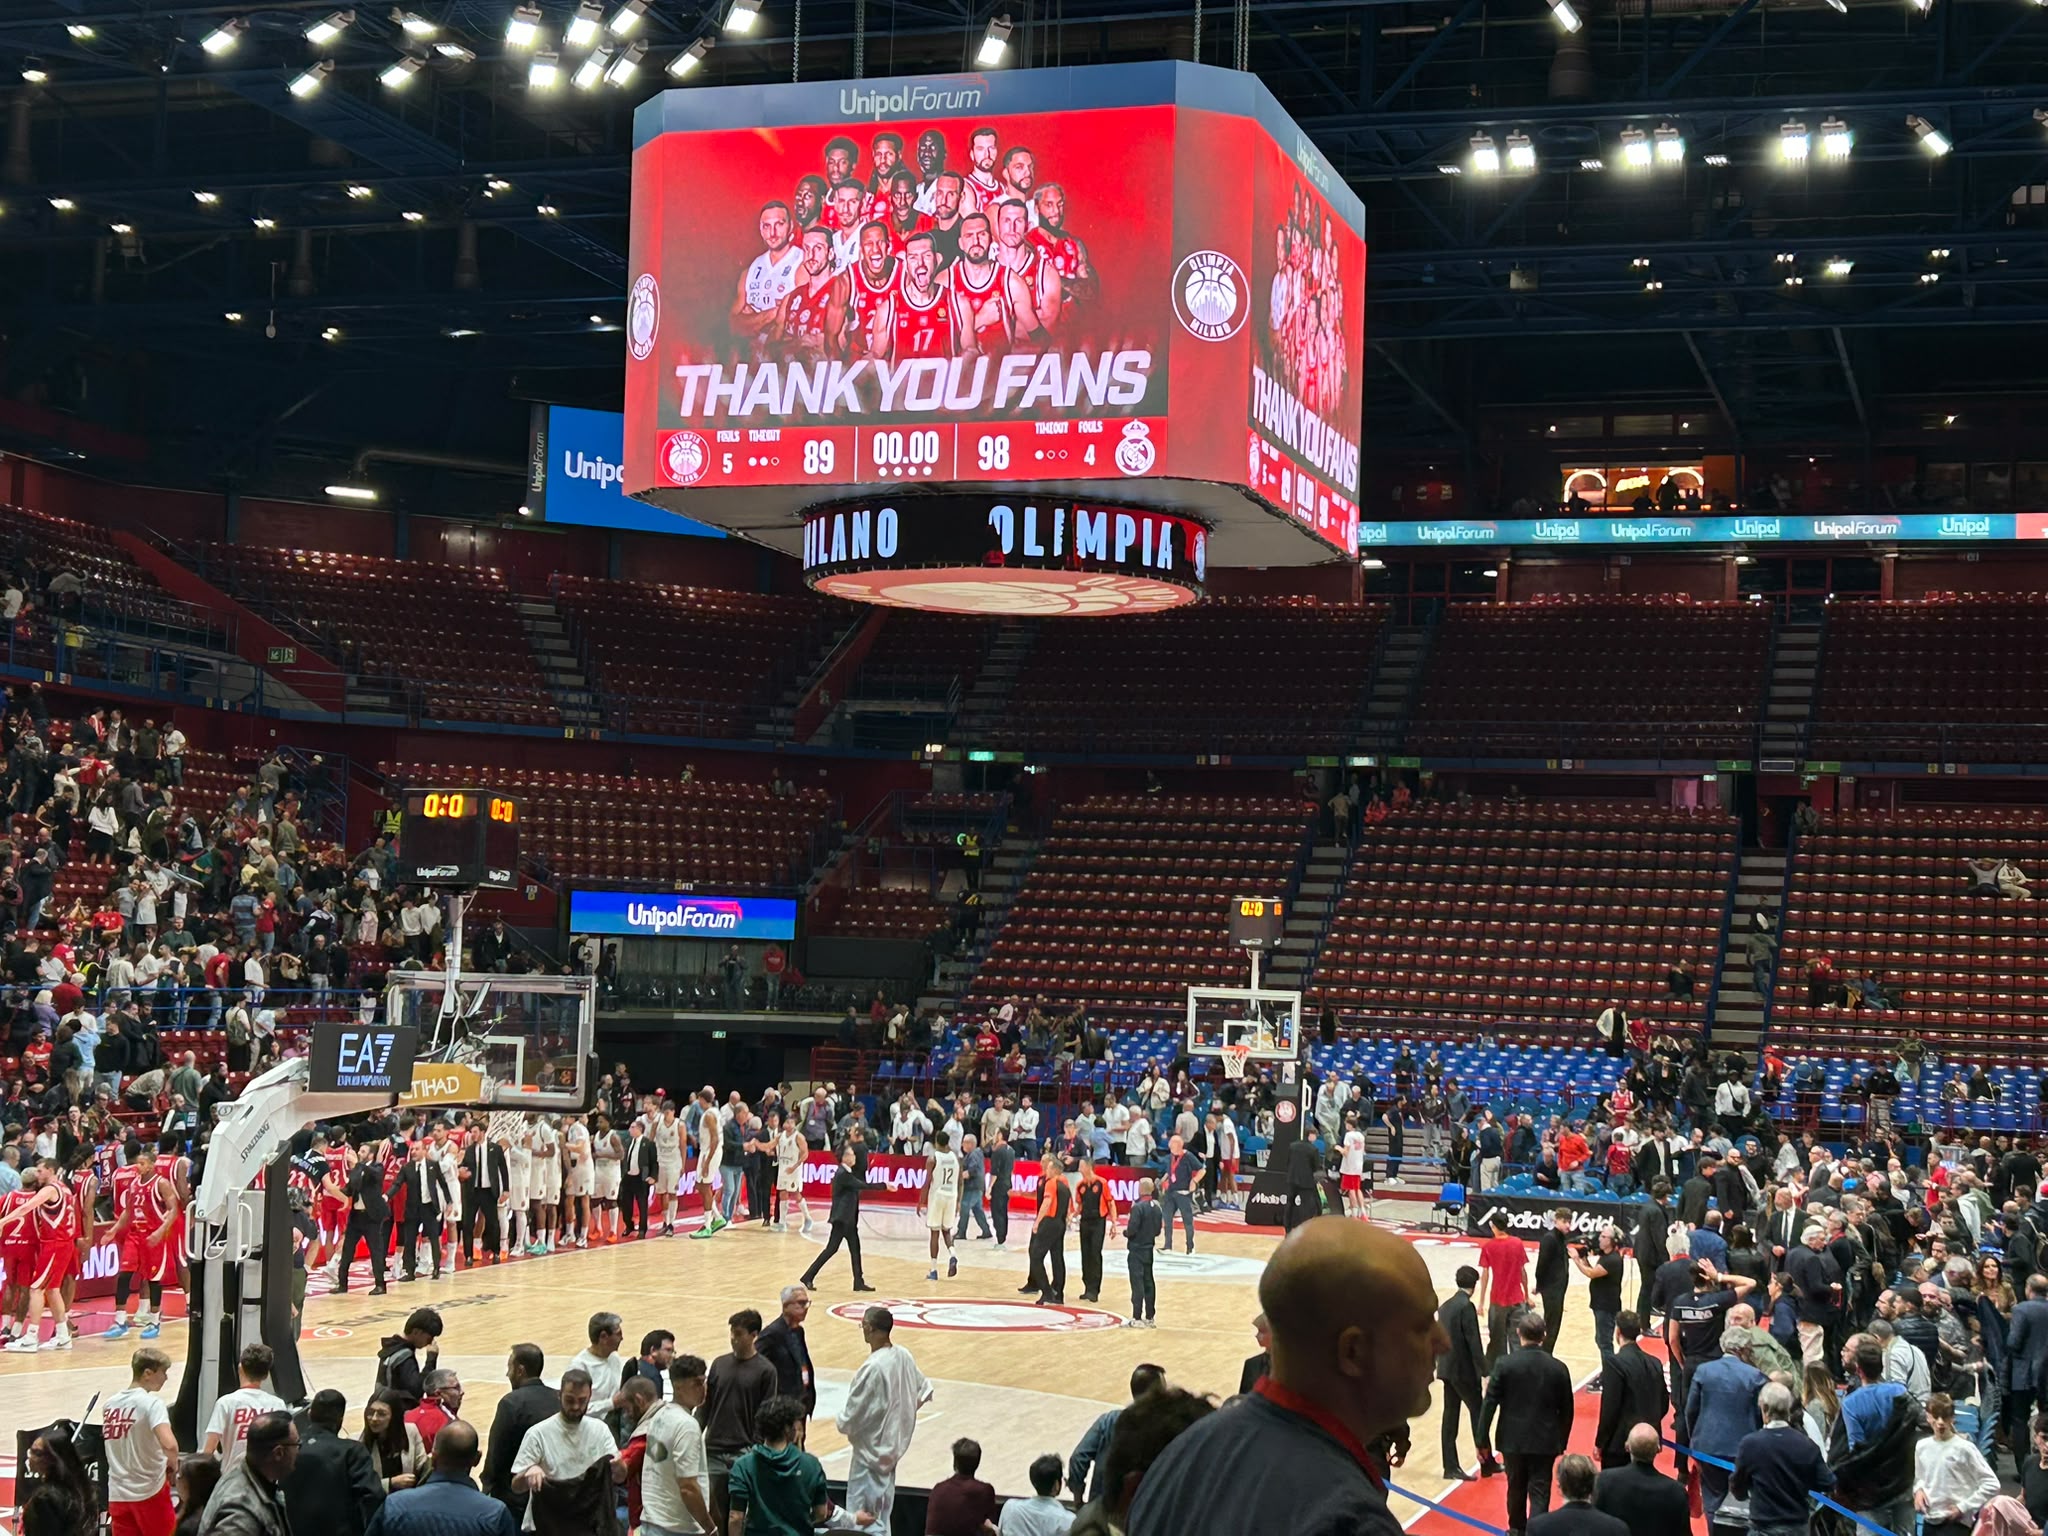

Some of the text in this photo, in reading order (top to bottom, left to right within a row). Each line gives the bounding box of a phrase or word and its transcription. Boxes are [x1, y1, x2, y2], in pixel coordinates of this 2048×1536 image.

[840, 85, 981, 121] UnipolForum
[1188, 254, 1235, 277] OLIMPIA
[1190, 318, 1232, 337] MILANO
[913, 328, 934, 351] 17
[675, 350, 1151, 417] THANK YOU FANS
[1035, 420, 1103, 434] TIMEOUT FOULS
[1253, 366, 1299, 450] THANK
[1298, 401, 1326, 469] YOU
[1324, 426, 1358, 493] FANS
[531, 433, 545, 492] UnipolForum
[722, 430, 1095, 475] 5 89 00.00 98 4
[565, 450, 624, 489] Unipo
[803, 507, 899, 570] MILANO
[989, 505, 1173, 570] OLIMPIA
[1417, 525, 1494, 541] UnipolForum
[1536, 521, 1579, 541] Unipol
[1611, 522, 1692, 541] UnipolForum
[1735, 519, 1780, 538] Unipol
[1814, 520, 1897, 540] UnipolForum
[1942, 517, 1990, 537] Unipol
[424, 794, 464, 818] 0:0
[628, 904, 737, 932] UnipolForum
[338, 1032, 395, 1074] EA7
[866, 1167, 927, 1189] MILAN
[943, 1168, 954, 1185] 12
[103, 1408, 136, 1423] BALL
[103, 1424, 131, 1440] BOY
